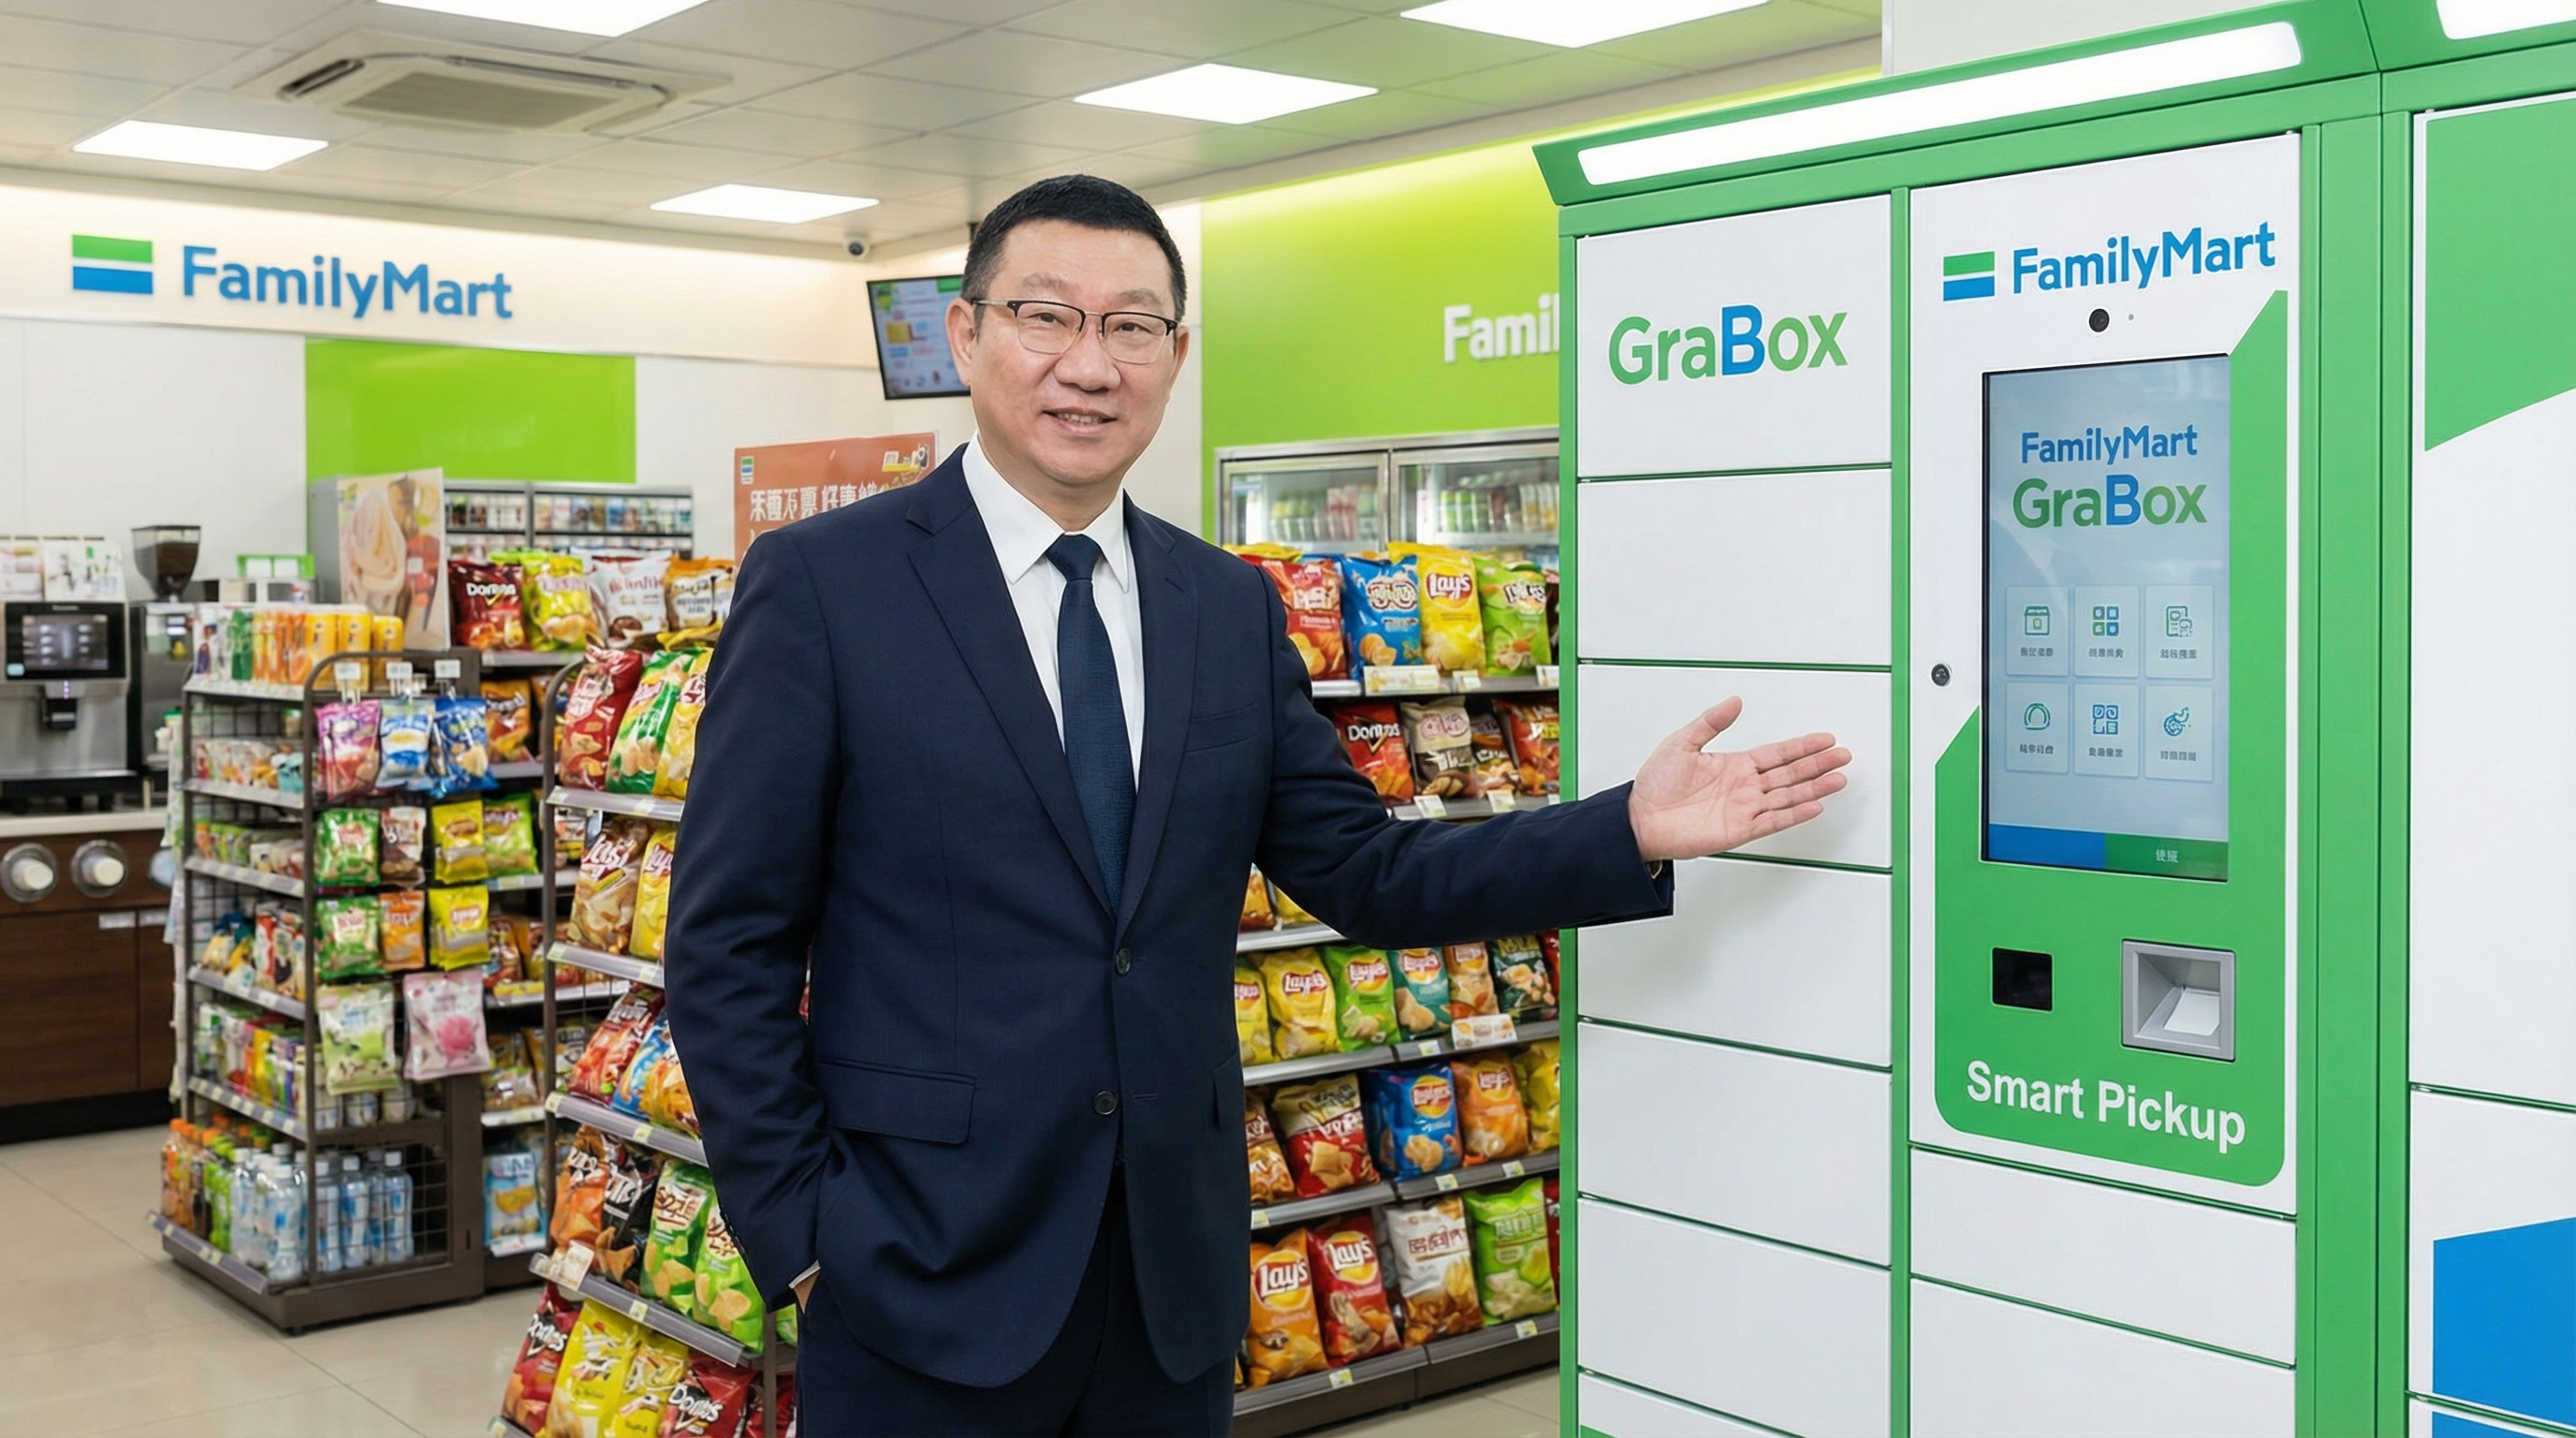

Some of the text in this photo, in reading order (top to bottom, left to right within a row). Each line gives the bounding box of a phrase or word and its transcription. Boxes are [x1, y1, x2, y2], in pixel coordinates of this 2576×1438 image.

[183, 245, 512, 318] FamilyMart
[2013, 221, 2276, 297] FamilyMart
[1608, 305, 1848, 385] GraBox
[2021, 424, 2198, 465] FamilyMart
[2012, 473, 2207, 529] GraBox
[1967, 1060, 2246, 1154] Smart Pickup
